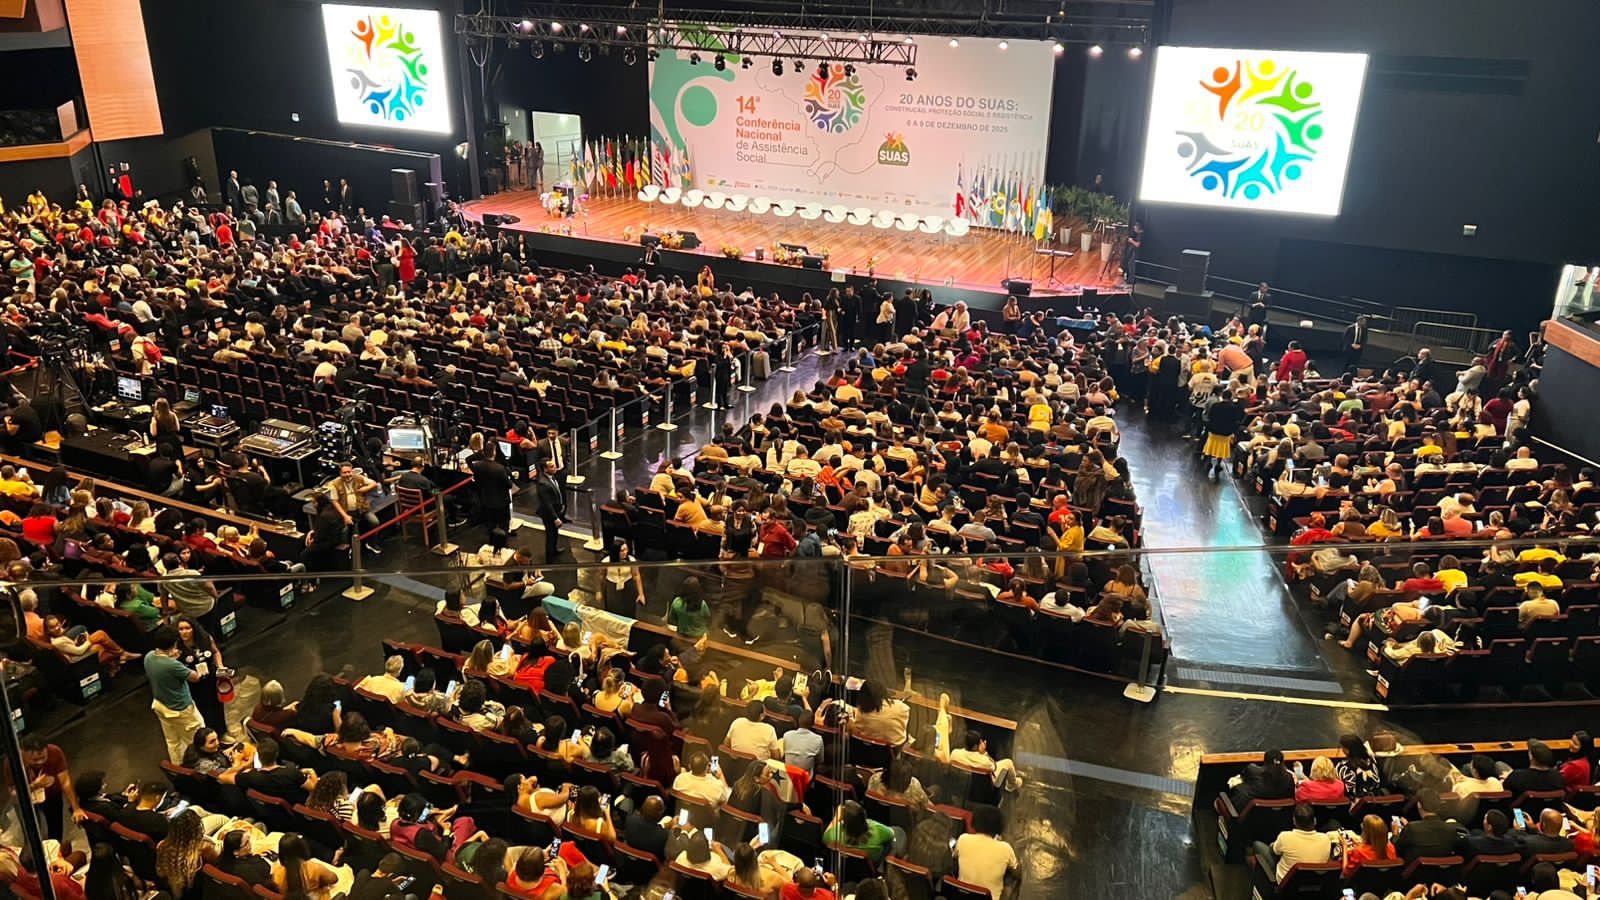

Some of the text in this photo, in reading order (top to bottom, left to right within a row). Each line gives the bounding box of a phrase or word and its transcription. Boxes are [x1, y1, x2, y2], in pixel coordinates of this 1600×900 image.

[828, 89, 841, 100] 20
[899, 94, 1019, 112] 20 ANOS DO SUAS:
[735, 116, 801, 131] Conferência
[925, 120, 936, 129] DE
[936, 121, 978, 132] DEZEMBRO
[979, 123, 989, 132] DE
[1234, 111, 1265, 132] 20
[735, 128, 782, 141] Nacional
[736, 141, 809, 156] de Assistência
[736, 151, 767, 164] Social
[879, 150, 909, 162] SUAS
